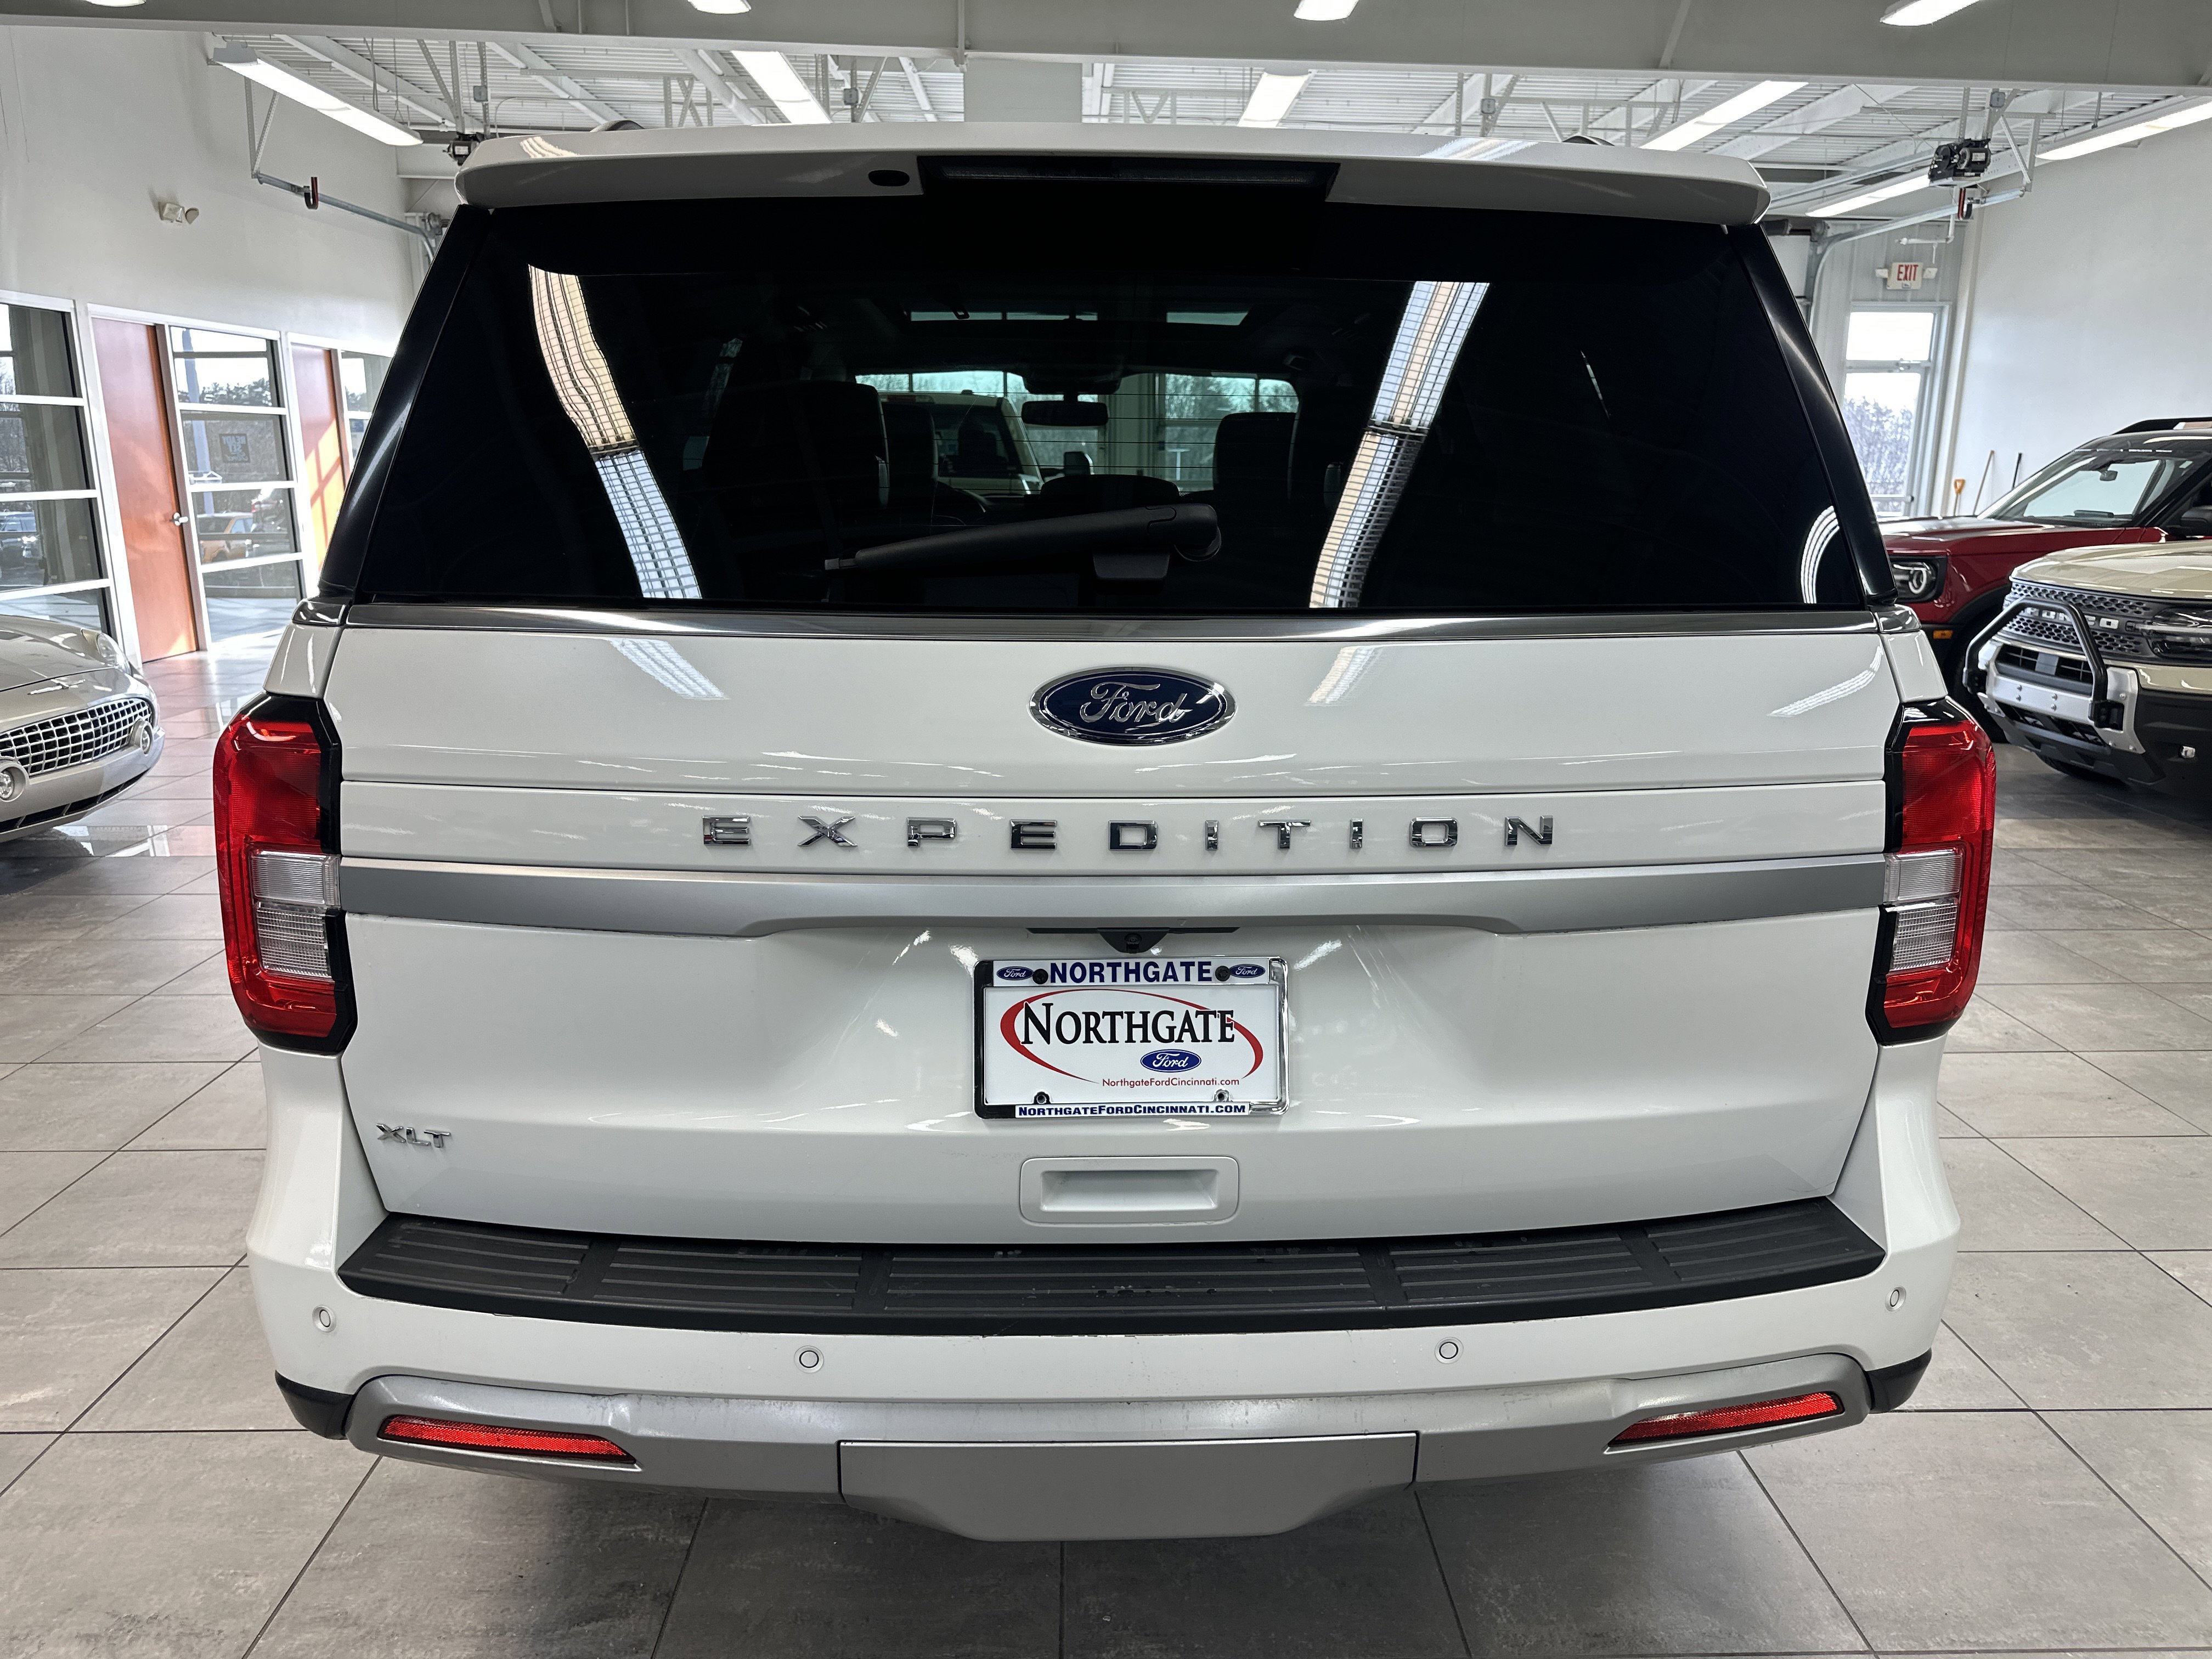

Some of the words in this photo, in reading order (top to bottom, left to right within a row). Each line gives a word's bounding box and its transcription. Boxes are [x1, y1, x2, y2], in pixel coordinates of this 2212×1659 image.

[1897, 264, 1918, 281] EXIT
[1080, 681, 1193, 724] Ford
[702, 815, 1553, 850] EXPEDITION
[1003, 967, 1026, 978] Ford
[1050, 961, 1212, 983] NORTHGATE
[1235, 966, 1257, 975] Ford
[1021, 1002, 1235, 1045] NORTHGATE
[1153, 1052, 1189, 1068] Ford
[1102, 1077, 1239, 1088] NorthgateFordCincinnati.com
[1019, 1104, 1245, 1116] NORTHGATEFORDCINCINNATI.COM
[376, 1123, 451, 1148] XLT
